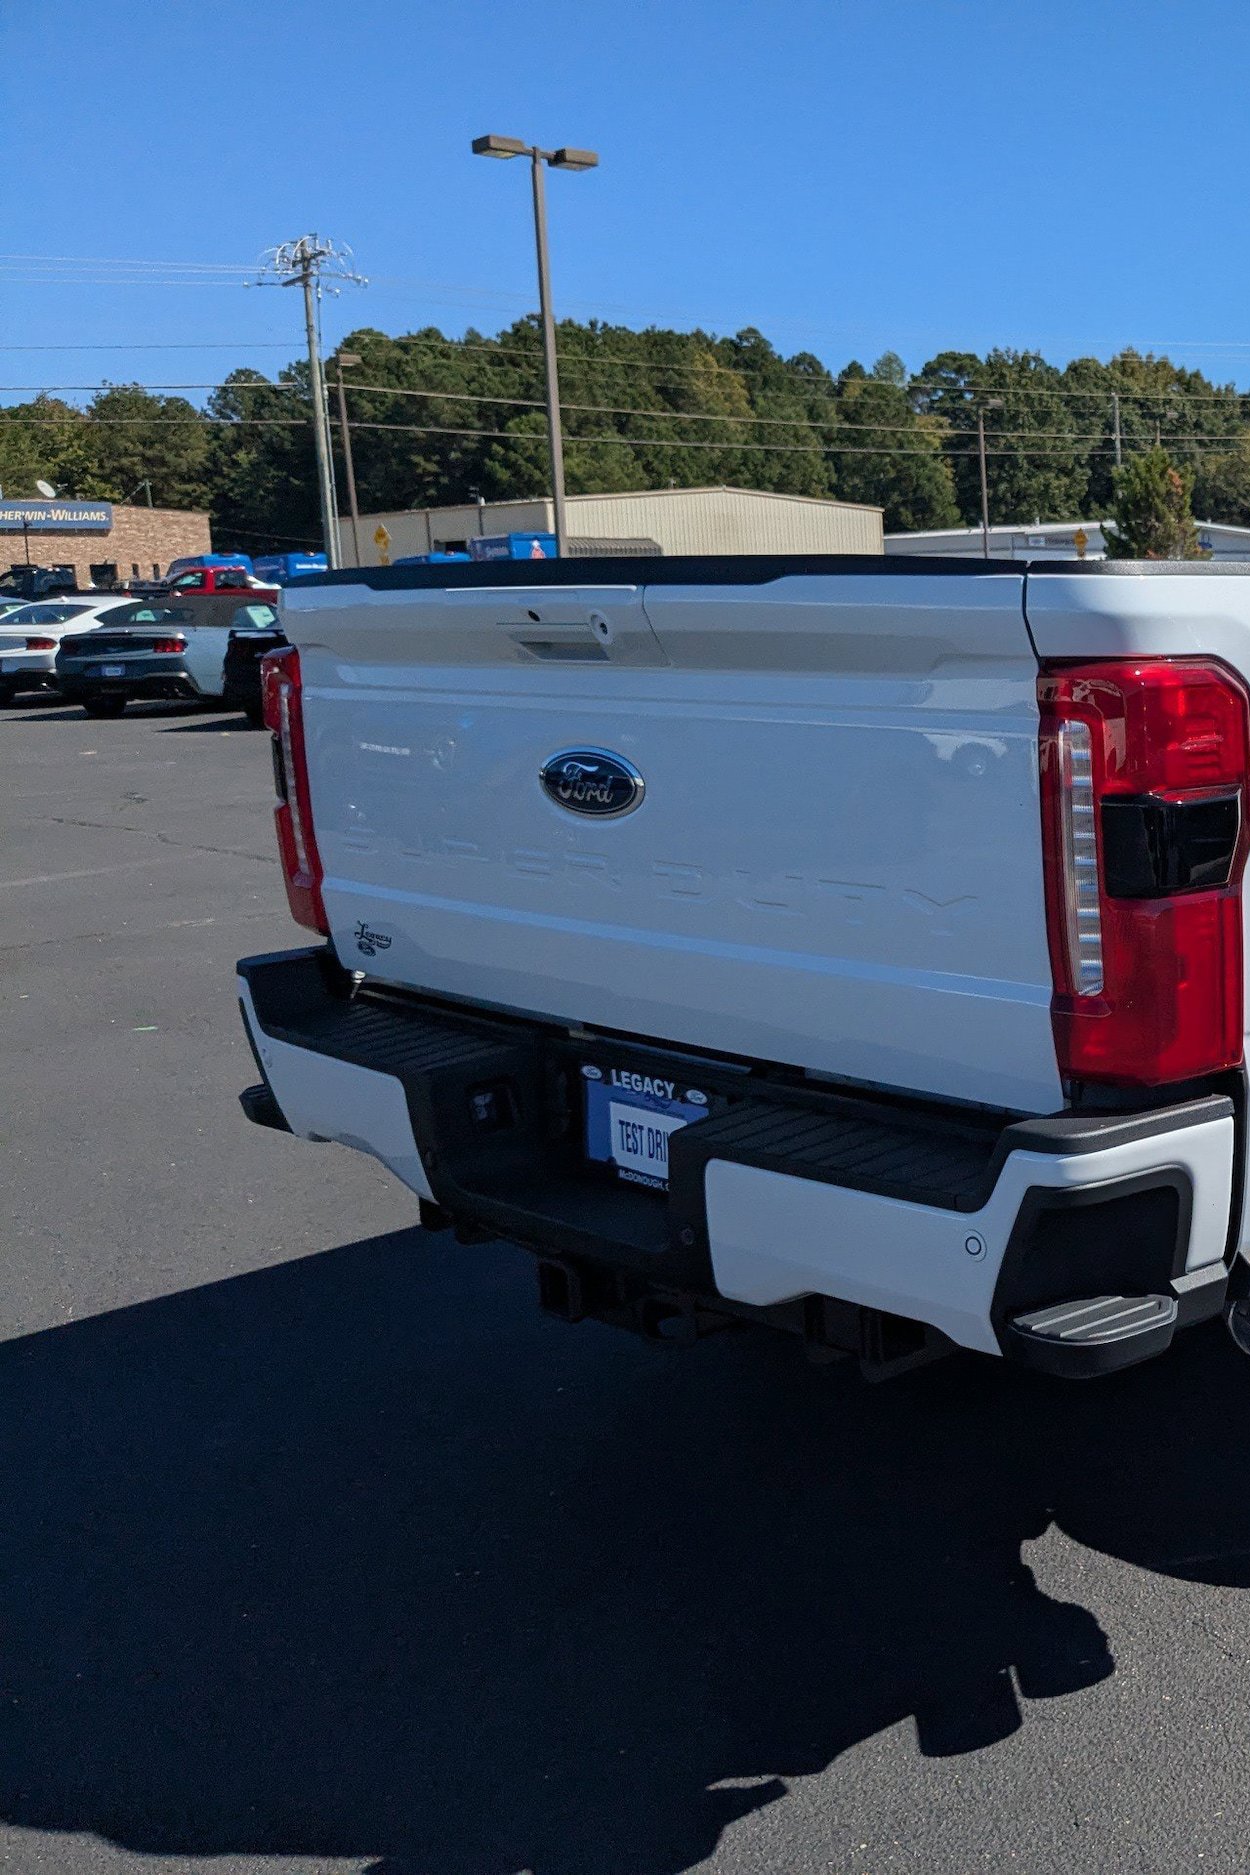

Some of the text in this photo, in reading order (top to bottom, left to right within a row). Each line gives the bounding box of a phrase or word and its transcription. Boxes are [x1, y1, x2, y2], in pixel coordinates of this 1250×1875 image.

[560, 761, 613, 803] Ford
[611, 1069, 675, 1099] LEGACY
[619, 1119, 669, 1162] TEST DRI
